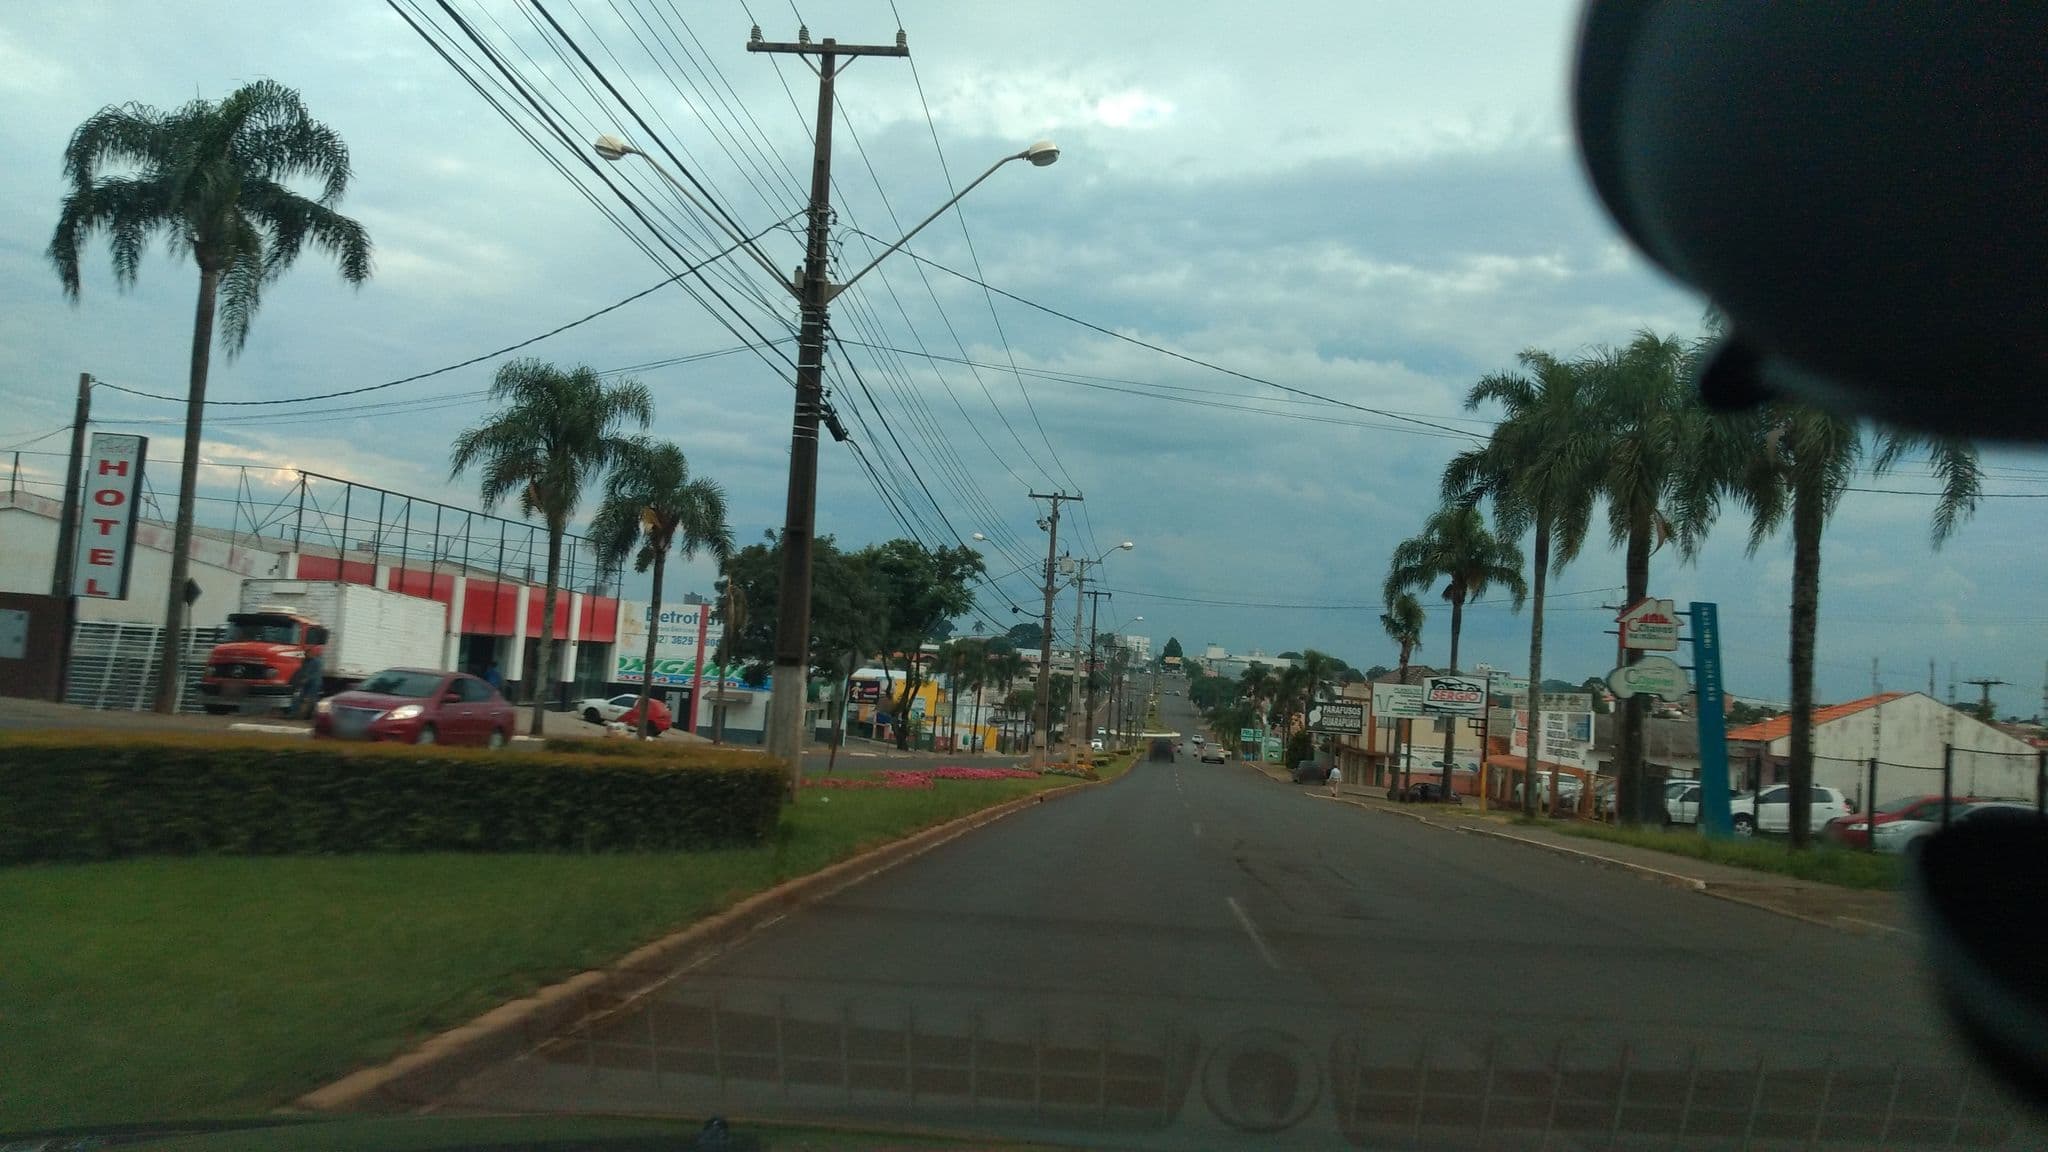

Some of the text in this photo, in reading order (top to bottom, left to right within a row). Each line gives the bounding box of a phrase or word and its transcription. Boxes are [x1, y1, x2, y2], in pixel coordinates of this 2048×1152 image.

[85, 459, 128, 596] HOTEL
[1431, 690, 1478, 701] SERGIO
[1323, 705, 1361, 716] PARAFUSOS
